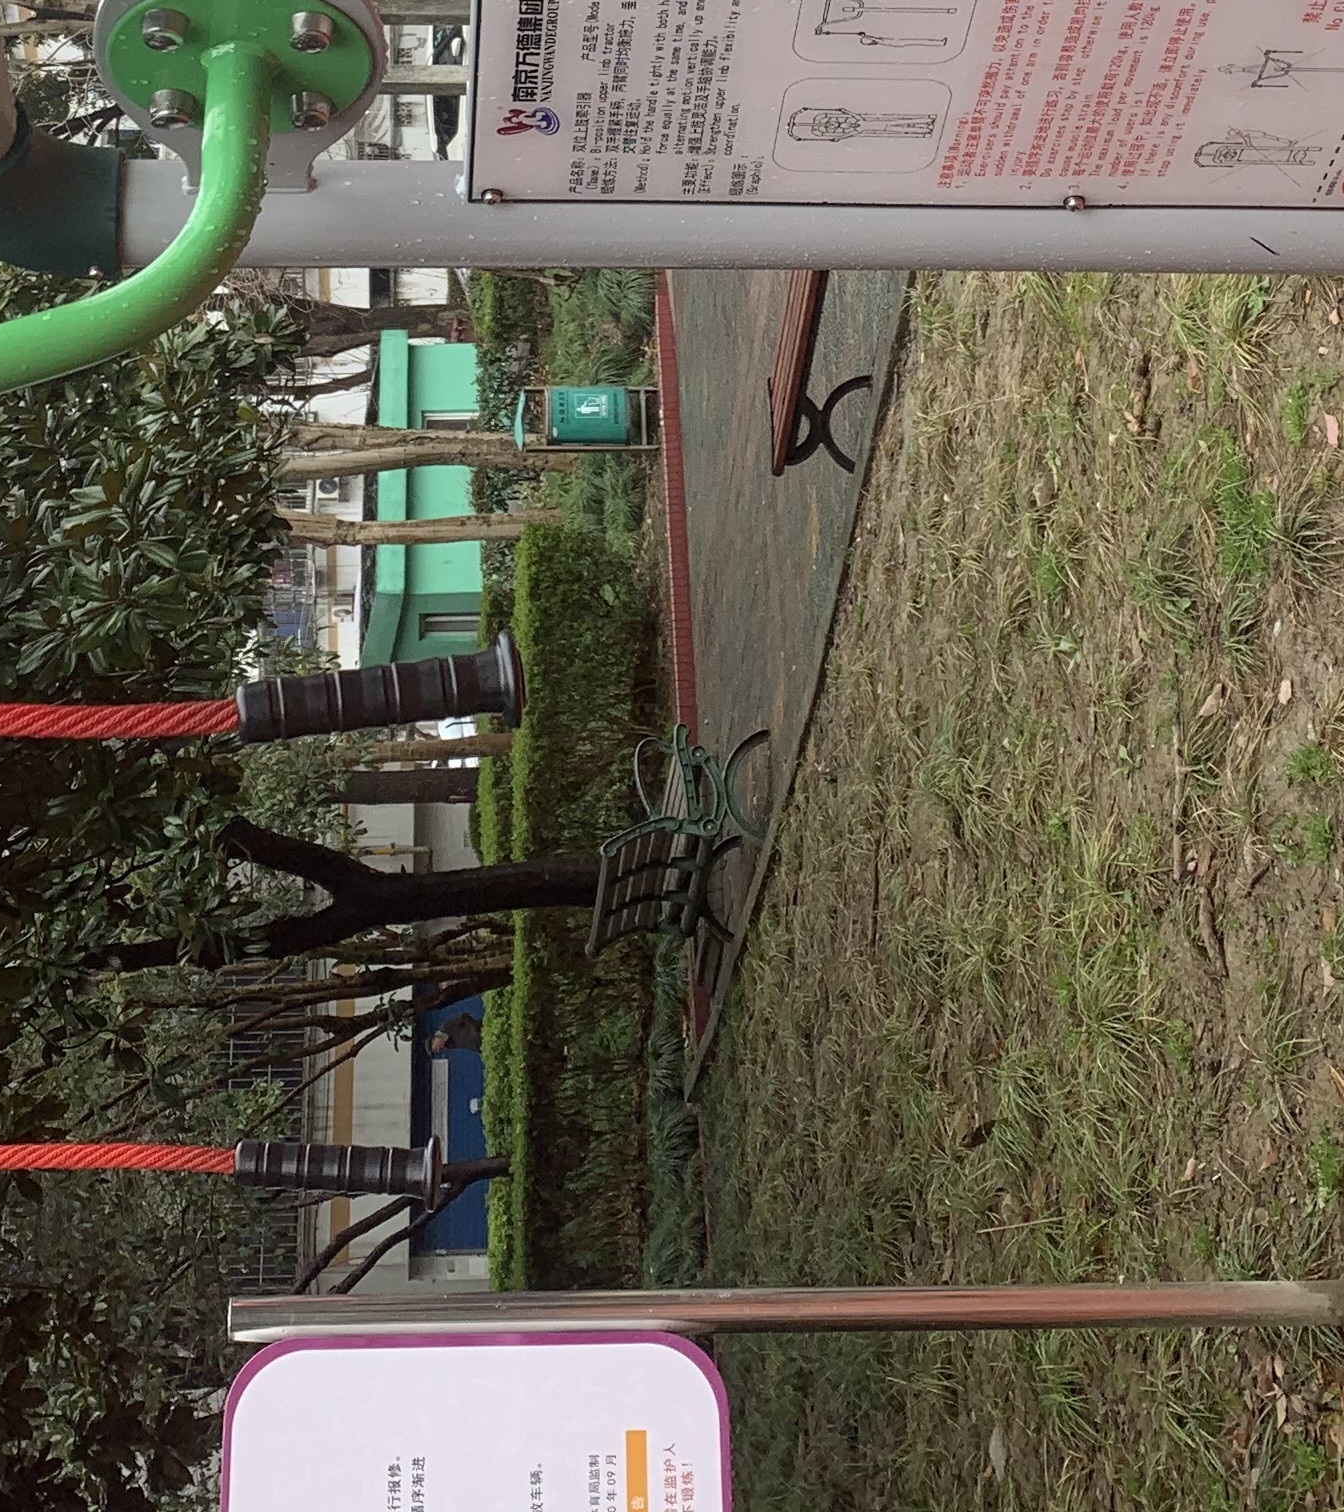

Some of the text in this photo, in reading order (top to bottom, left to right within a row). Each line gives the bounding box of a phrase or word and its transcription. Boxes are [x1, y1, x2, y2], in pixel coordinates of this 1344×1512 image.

[654, 10, 672, 29] both
[674, 2, 690, 16] and
[1019, 6, 1036, 20] the
[690, 16, 705, 25] up
[1015, 24, 1031, 34] to
[1032, 11, 1052, 35] order
[600, 23, 616, 55] tractor
[651, 33, 668, 52] with
[717, 12, 741, 62] flexibility
[1075, 16, 1103, 59] otherwise
[1180, 31, 1205, 61] during
[539, 0, 560, 103] NANJINGWANDEGROUP
[668, 47, 684, 65] same
[683, 29, 703, 75] vertically
[1001, 39, 1027, 81] attention
[1022, 53, 1039, 68] arm
[598, 59, 612, 76] limb
[647, 56, 665, 86] tightly
[665, 70, 680, 83] the
[714, 66, 732, 83] limb
[1017, 72, 1034, 87] one
[1162, 65, 1193, 110] discomfort
[595, 82, 610, 103] upper
[663, 87, 678, 96] at
[678, 78, 695, 105] motion
[710, 88, 728, 110] upper
[996, 86, 1013, 99] pay
[1013, 90, 1028, 99] of
[1062, 90, 1079, 100] by
[643, 91, 661, 117] handle
[1055, 104, 1075, 121] step
[659, 100, 676, 130] equally
[987, 103, 1008, 130] should
[1119, 113, 1139, 135] users
[1156, 114, 1174, 127] any
[641, 121, 656, 133] the
[671, 109, 691, 155] alternating
[703, 113, 724, 156] Strengthen
[1089, 164, 1107, 177] The
[1114, 92, 1132, 105] per
[638, 137, 654, 155] Hold
[655, 134, 671, 155] force
[1041, 126, 1068, 165] exercises
[1064, 126, 1084, 152] muscle
[1115, 139, 1130, 147] of
[1162, 135, 1183, 157] using
[990, 151, 1010, 177] sudden
[1105, 151, 1125, 178] number
[1142, 144, 1163, 165] there
[1037, 168, 1054, 178] Do
[1056, 156, 1074, 177] cause
[1154, 161, 1173, 178] stop
[606, 1454, 616, 1466] 月
[387, 1457, 402, 1512] 行报修。
[589, 1454, 600, 1512] 育局监制
[607, 1470, 616, 1485] 09
[663, 1443, 678, 1512] 在监护人
[606, 1490, 617, 1501] 年
